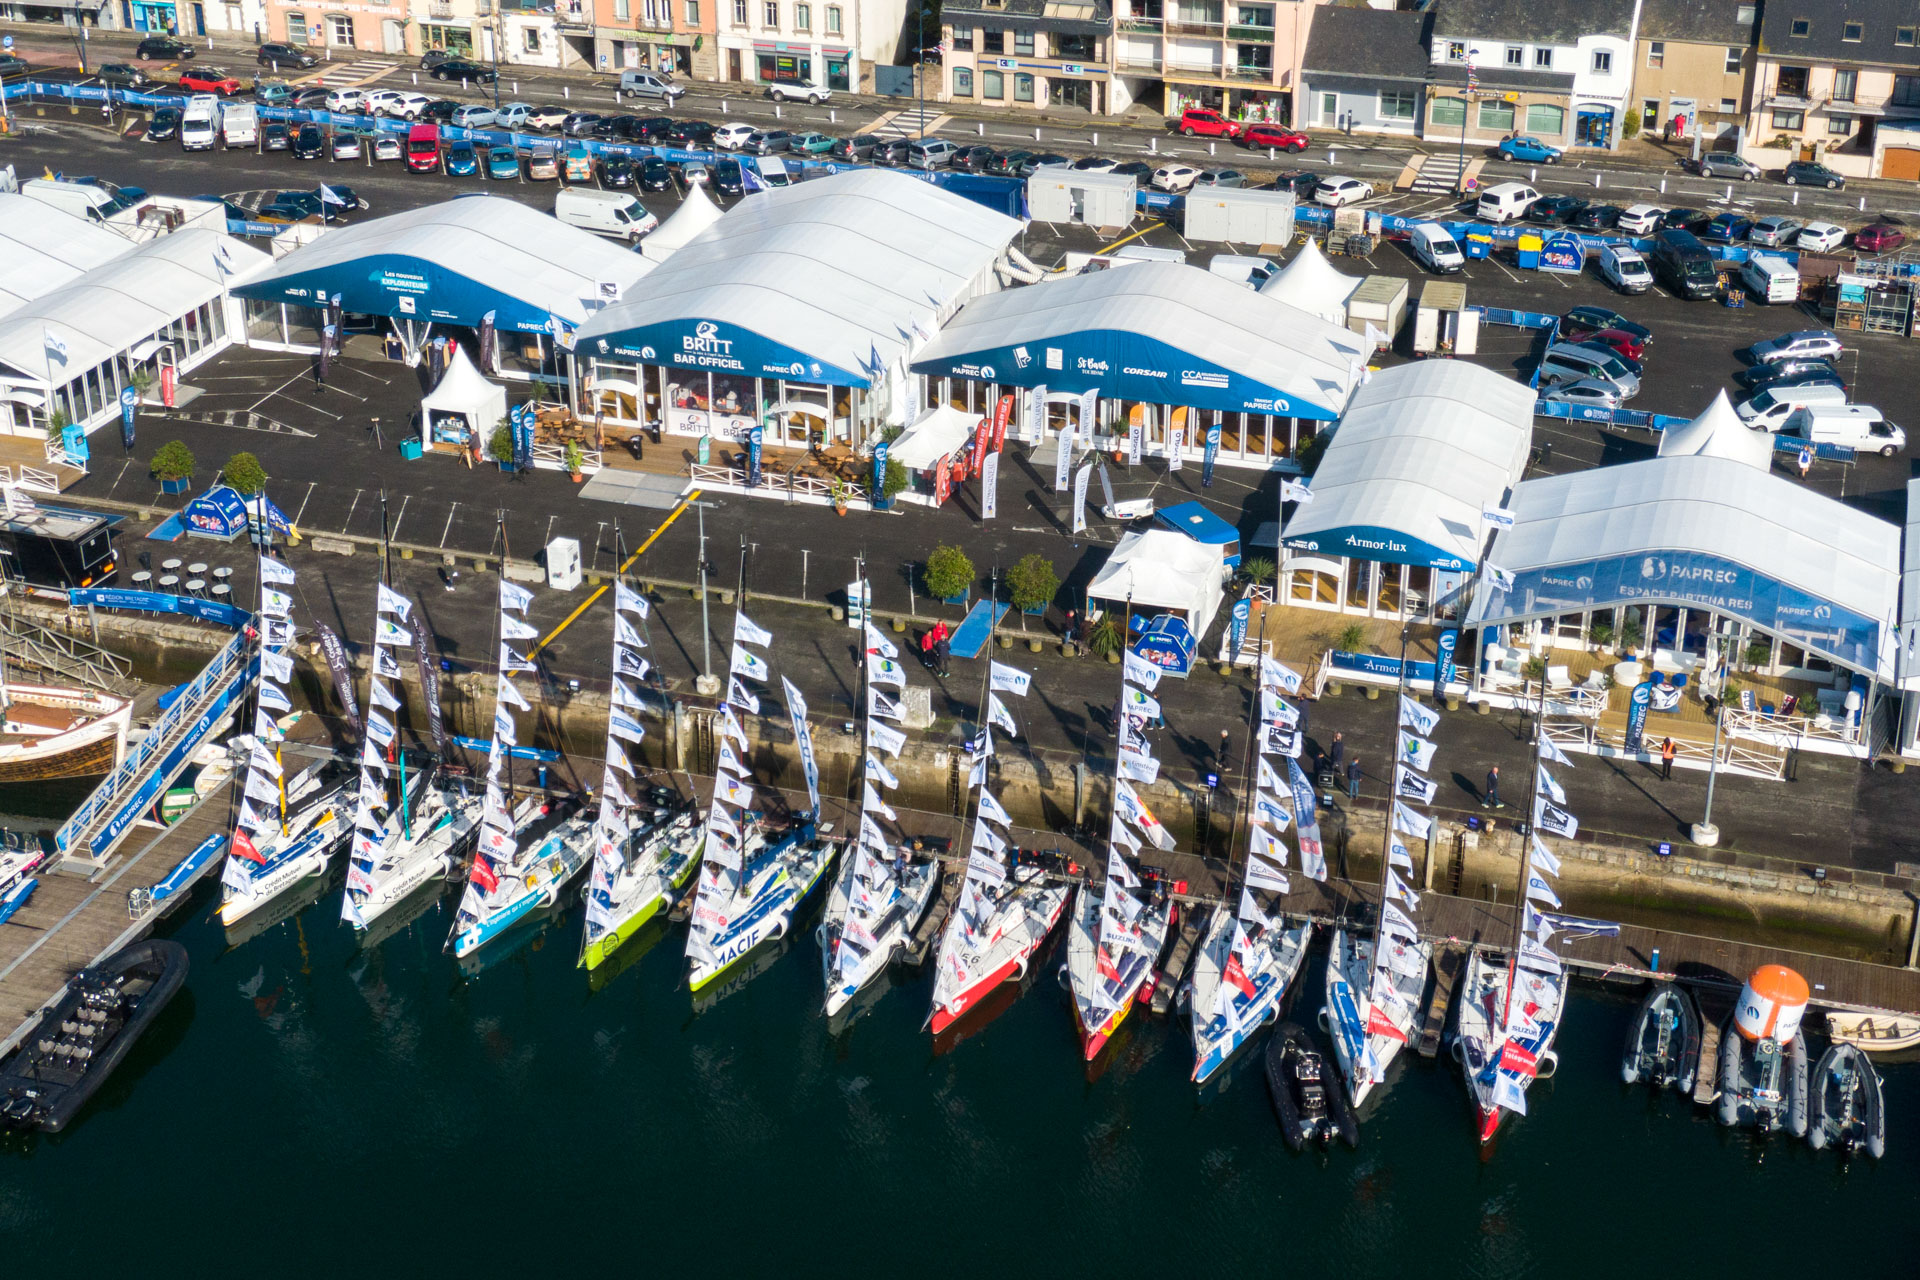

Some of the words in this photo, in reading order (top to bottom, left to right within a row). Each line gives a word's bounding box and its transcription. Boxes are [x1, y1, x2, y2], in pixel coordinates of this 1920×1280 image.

[385, 270, 395, 278] Les
[382, 278, 428, 290] EXPLORATEURS
[517, 322, 544, 331] PAPREC
[683, 336, 732, 354] BRITT
[614, 348, 641, 358] PAPREC
[674, 353, 696, 364] BAR
[698, 356, 744, 370] OFFICIEL
[1077, 356, 1087, 369] St
[1088, 358, 1110, 371] Barth
[762, 364, 790, 374] PAPREC
[952, 366, 980, 377] PAPREC
[1122, 367, 1168, 379] CORSAIR
[1181, 370, 1202, 380] CCA
[1244, 402, 1273, 410] PAPREC
[680, 422, 709, 433] BRITT
[754, 446, 762, 473] PAPREC
[1288, 542, 1308, 550] PAPREC
[1430, 560, 1450, 568] PAPREC
[1671, 565, 1738, 584] PAPREC
[1542, 576, 1574, 588] PAPREC
[1620, 585, 1666, 600] ESPACE
[1778, 606, 1811, 616] PAPREC
[1237, 621, 1246, 651] PAPREC
[736, 664, 761, 677] PAPREC
[1440, 652, 1452, 684] PAPREC
[874, 672, 898, 681] PAPREC
[992, 675, 1014, 683] PAPREC
[1128, 704, 1152, 714] PAPREC
[1635, 705, 1647, 738] PAPREC
[182, 730, 201, 753] PAPREC
[1132, 759, 1154, 772] Finistère
[120, 796, 144, 824] PAPREC
[482, 844, 508, 859] SUZUKI
[776, 840, 797, 860] MACIF
[970, 857, 985, 868] CCA
[1250, 864, 1267, 874] CCA
[264, 876, 281, 890] Crédit
[282, 866, 302, 880] Mutuel
[392, 882, 407, 894] Crédit
[408, 868, 427, 884] Mutuel
[266, 888, 273, 896] de
[273, 874, 298, 894] Bretagne
[393, 891, 400, 900] de
[400, 877, 424, 896] Bretagne
[1385, 910, 1401, 920] CCA
[1106, 932, 1136, 946] SUZUKI
[715, 928, 760, 970] MACIF
[1522, 944, 1538, 955] CCA
[1504, 1051, 1536, 1068] Télégramme
